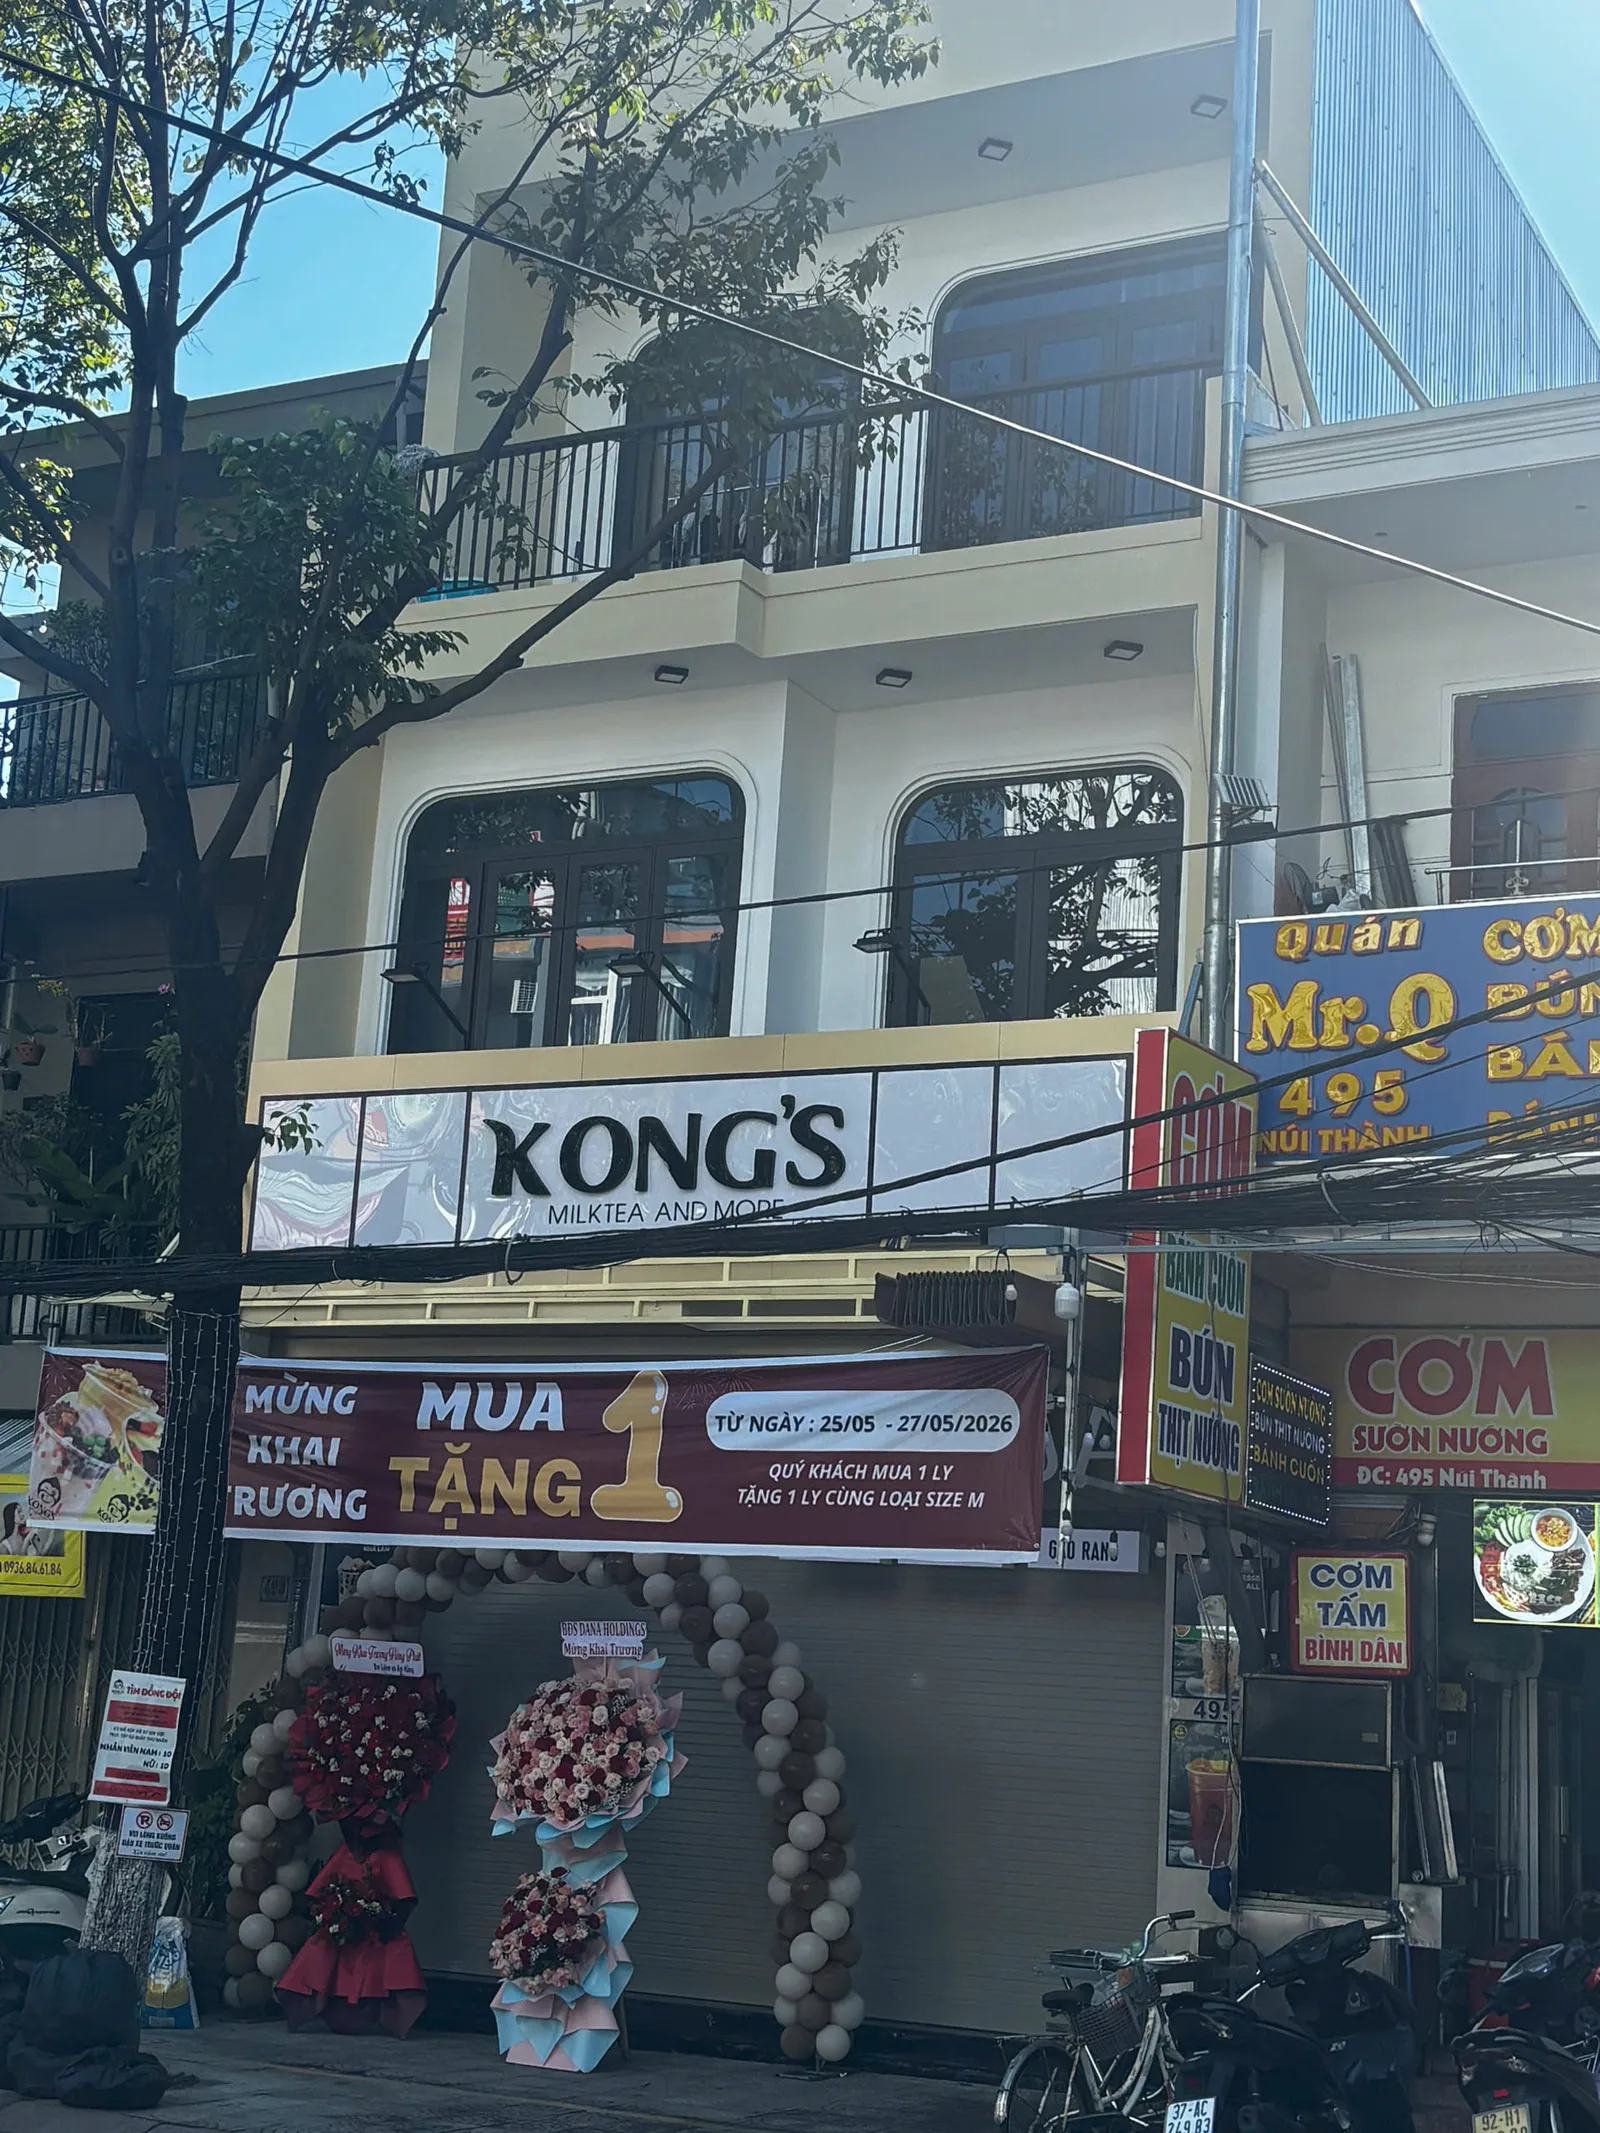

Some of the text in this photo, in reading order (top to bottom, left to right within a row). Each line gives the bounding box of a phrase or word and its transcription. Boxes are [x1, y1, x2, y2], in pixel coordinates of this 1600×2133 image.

[1274, 914, 1424, 963] Quán
[1245, 971, 1457, 1062] Mr.Q
[1279, 1069, 1408, 1118] 495
[482, 1094, 847, 1197] KONG'S
[1170, 1074, 1252, 1200] CƠM
[1259, 1120, 1432, 1154] NÚI THÀNH
[654, 1201, 708, 1222] AND
[1165, 1231, 1205, 1300] BÁNH
[1169, 1326, 1235, 1403] BÚN
[1348, 1337, 1554, 1416] CƠM
[244, 1373, 359, 1415] MỪNG
[416, 1381, 565, 1432] MUA
[715, 1411, 745, 1433] TỪ
[749, 1411, 804, 1433] NGÀY
[819, 1415, 876, 1433] 25/05
[897, 1414, 1013, 1433] 27/05/2026
[1158, 1403, 1191, 1466] THỊT
[1192, 1411, 1240, 1472] NƯỚNG
[1254, 1409, 1272, 1435] BÚN
[1274, 1418, 1292, 1446] THỊT
[1352, 1421, 1548, 1455] SƯỜN NƯỚNG
[246, 1435, 341, 1467] KHAI
[590, 1369, 683, 1522] 1
[768, 1459, 954, 1481] QUÝ KHÁCH MUA 1 LY
[1254, 1442, 1325, 1486] BÁNH CUỐN
[1357, 1466, 1548, 1490] ĐC: 495 Núi Thành
[228, 1483, 367, 1521] RƯƠNG
[388, 1442, 582, 1530] TẶNG
[737, 1485, 985, 1511] TẶNG 1 LY CÙNG LOẠI SIZE M
[4, 1561, 62, 1576] 0936.84.61.84
[1310, 1561, 1392, 1589] CƠM
[1316, 1592, 1386, 1628] TẤM
[579, 1622, 602, 1637] DANA
[603, 1622, 646, 1637] HOLDINGS
[589, 1642, 608, 1656] Khai
[1305, 1634, 1354, 1662] BÌNH
[1360, 1636, 1403, 1664] DÂN
[127, 1684, 141, 1695] TÌM
[140, 1747, 158, 1757] NAM
[1173, 2100, 1208, 2120] 37-AC
[1482, 2108, 1520, 2131] 92-H1
